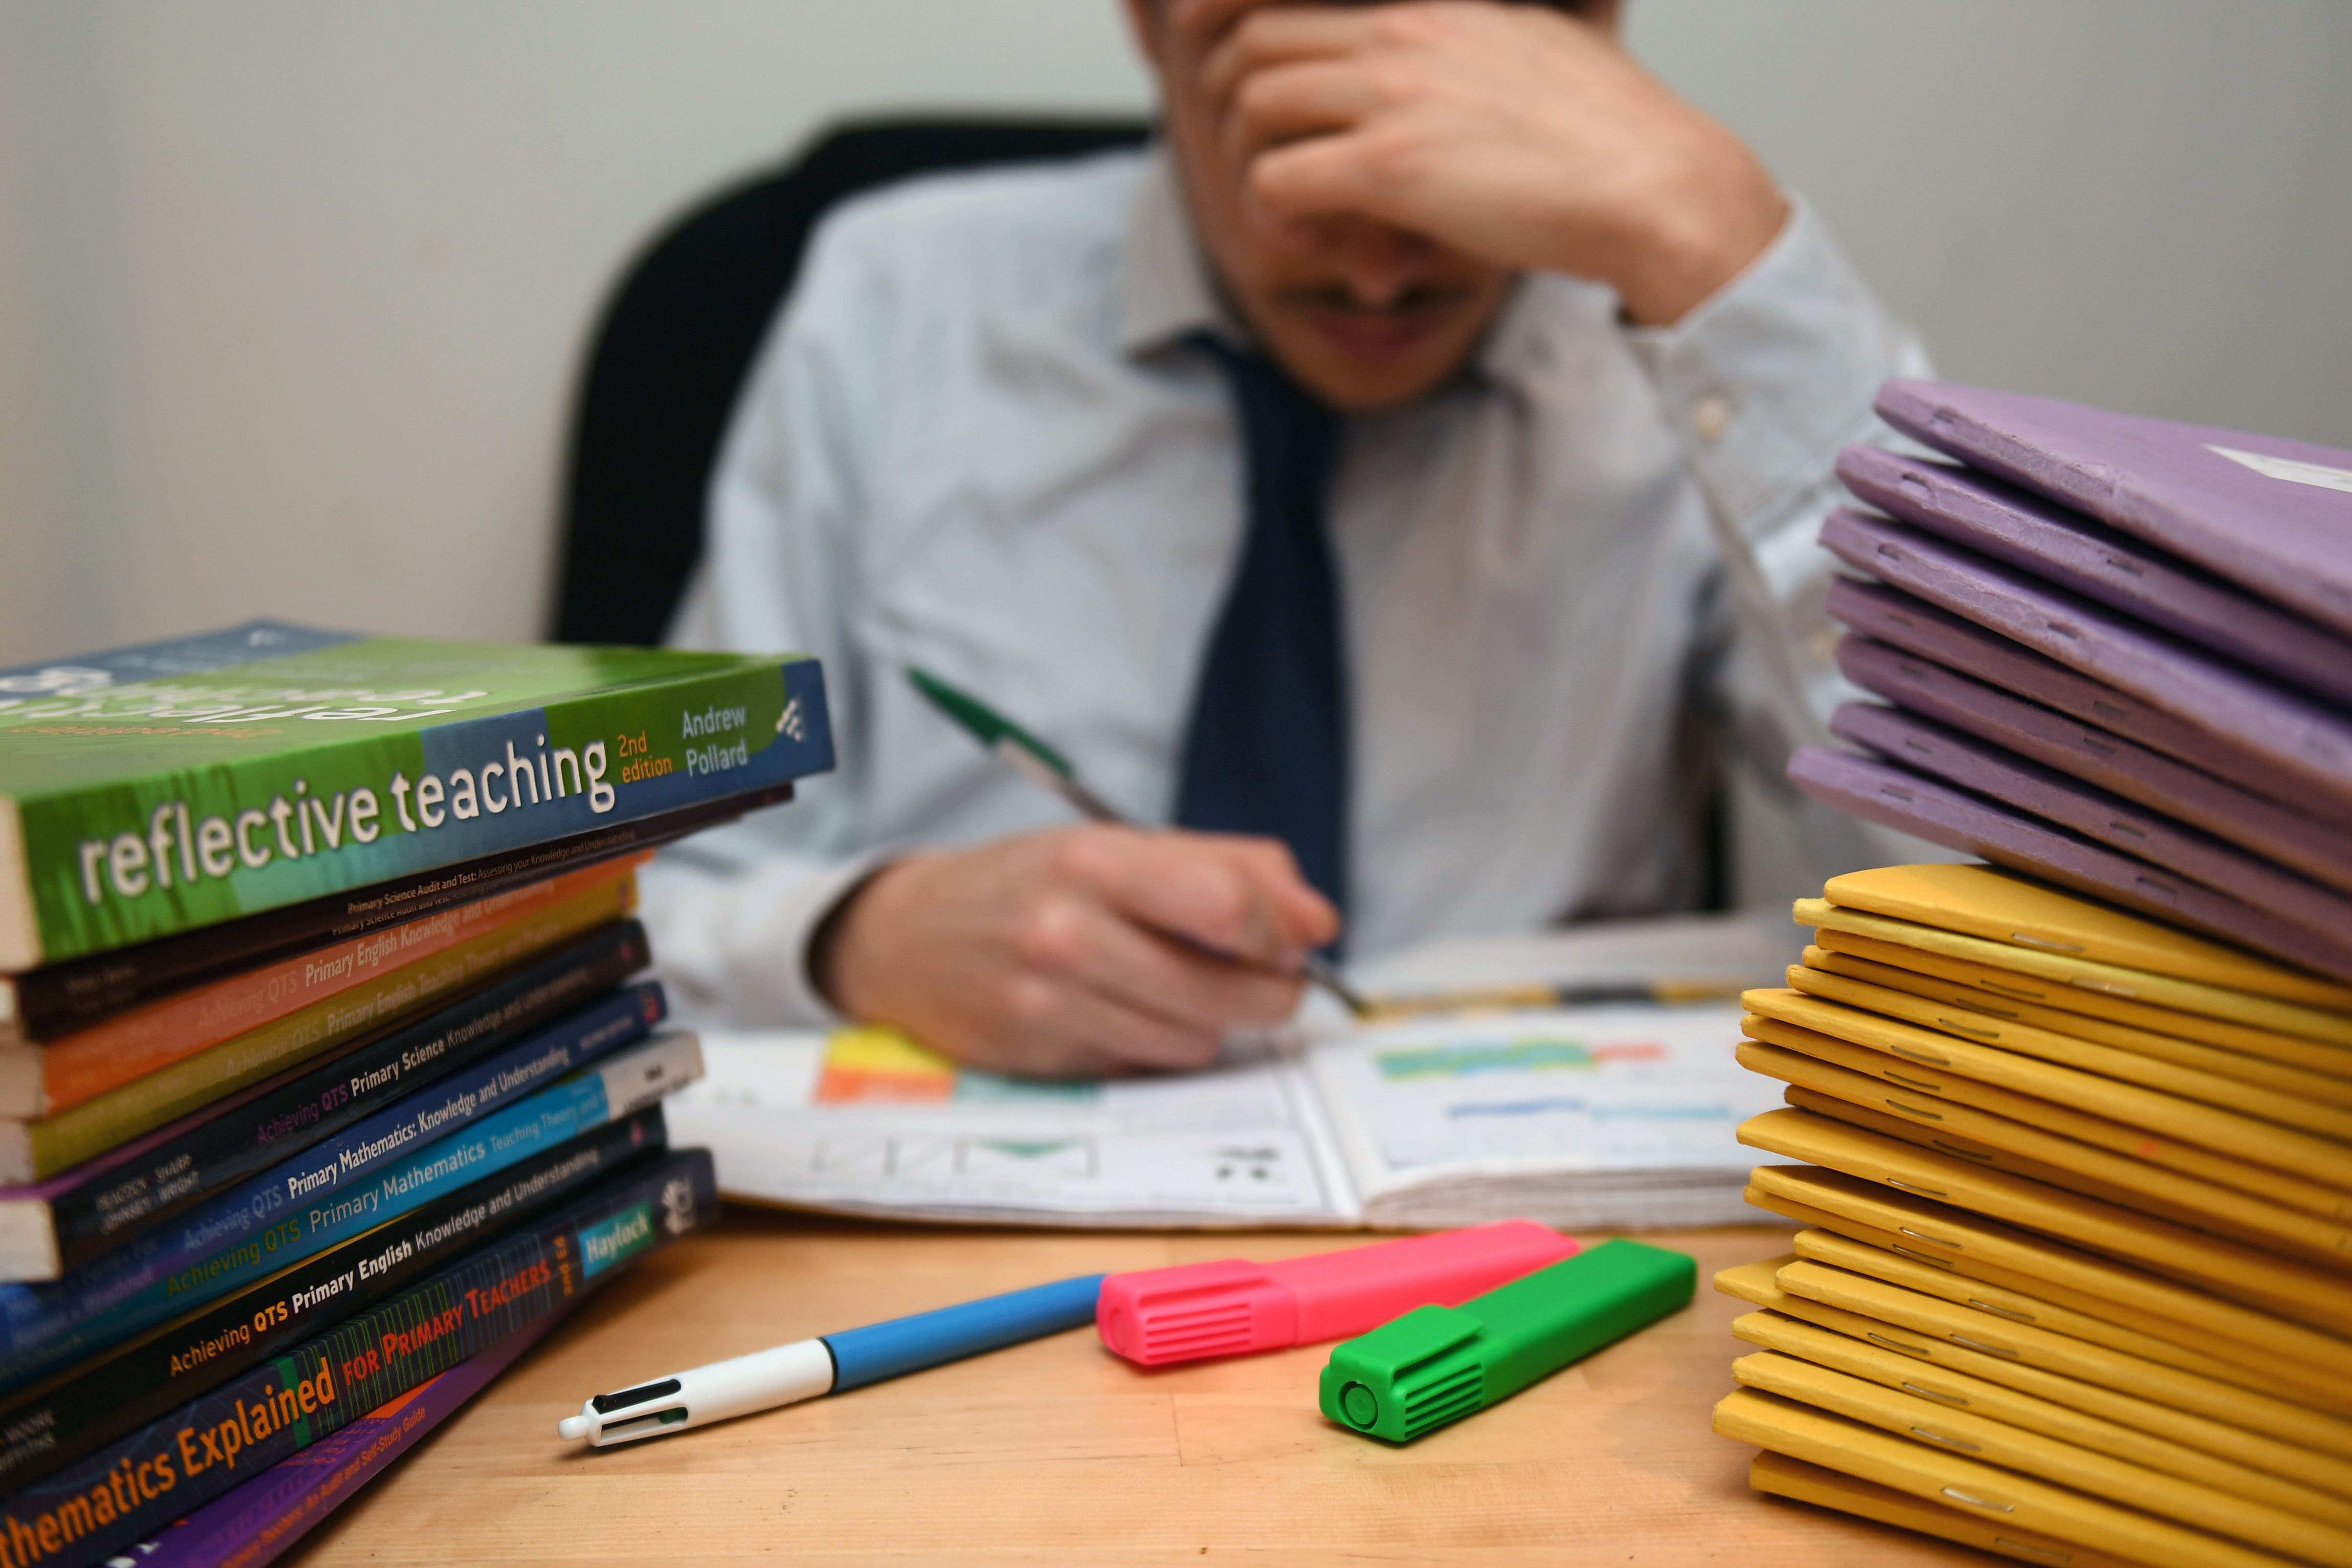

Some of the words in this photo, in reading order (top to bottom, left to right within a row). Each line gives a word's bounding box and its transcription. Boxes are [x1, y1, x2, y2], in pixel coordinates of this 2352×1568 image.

[618, 730, 647, 757] 2nd
[683, 705, 745, 739] Andrew
[686, 739, 747, 777] Pollard
[622, 756, 673, 783] edition
[79, 779, 380, 905] reflective
[389, 734, 616, 832] teaching
[348, 897, 383, 914] Primary
[384, 889, 415, 905] Science
[418, 881, 440, 895] Audit
[442, 875, 457, 890] and
[458, 871, 477, 884] Test:
[478, 863, 513, 879] Assessing
[514, 859, 529, 873] your
[531, 847, 569, 864] Knowledge
[571, 843, 584, 854] and
[585, 832, 635, 850] Understanding
[270, 970, 297, 1004] QTS
[306, 954, 354, 987] Primary
[358, 932, 397, 966] English
[401, 912, 459, 949] Knowledge
[327, 1002, 373, 1035] Primary
[377, 980, 415, 1015] English
[258, 1102, 319, 1145] Achieving
[322, 1083, 348, 1111] QTS
[351, 1061, 399, 1097] Primary
[402, 1039, 444, 1071] Science
[447, 1011, 502, 1048] Knowledge
[252, 1185, 283, 1220] QTS
[287, 1163, 337, 1199] Primary
[339, 1124, 417, 1173] Mathematics:
[418, 1094, 476, 1133] Knowledge
[479, 1082, 498, 1103] and
[498, 1047, 570, 1092] Understanding
[167, 1242, 260, 1297] Achieving
[263, 1220, 301, 1252] QTS
[309, 1189, 379, 1233] Primary
[383, 1142, 485, 1200] Mathematics
[490, 1121, 540, 1153] Teaching
[586, 1211, 649, 1263] Haylock
[170, 1324, 250, 1377] Achieving
[254, 1301, 288, 1332] QTS
[292, 1270, 353, 1314] Primary
[358, 1239, 412, 1281] English
[415, 1204, 485, 1251] Knowledge
[489, 1189, 512, 1215] and
[513, 1149, 599, 1200] Understanding
[177, 1357, 336, 1479] Explained
[343, 1350, 380, 1386] FOR
[381, 1303, 464, 1365] PRIMARY
[465, 1259, 551, 1319] TEACHERS
[361, 1426, 401, 1466] Self-Study
[403, 1407, 427, 1433] Guide
